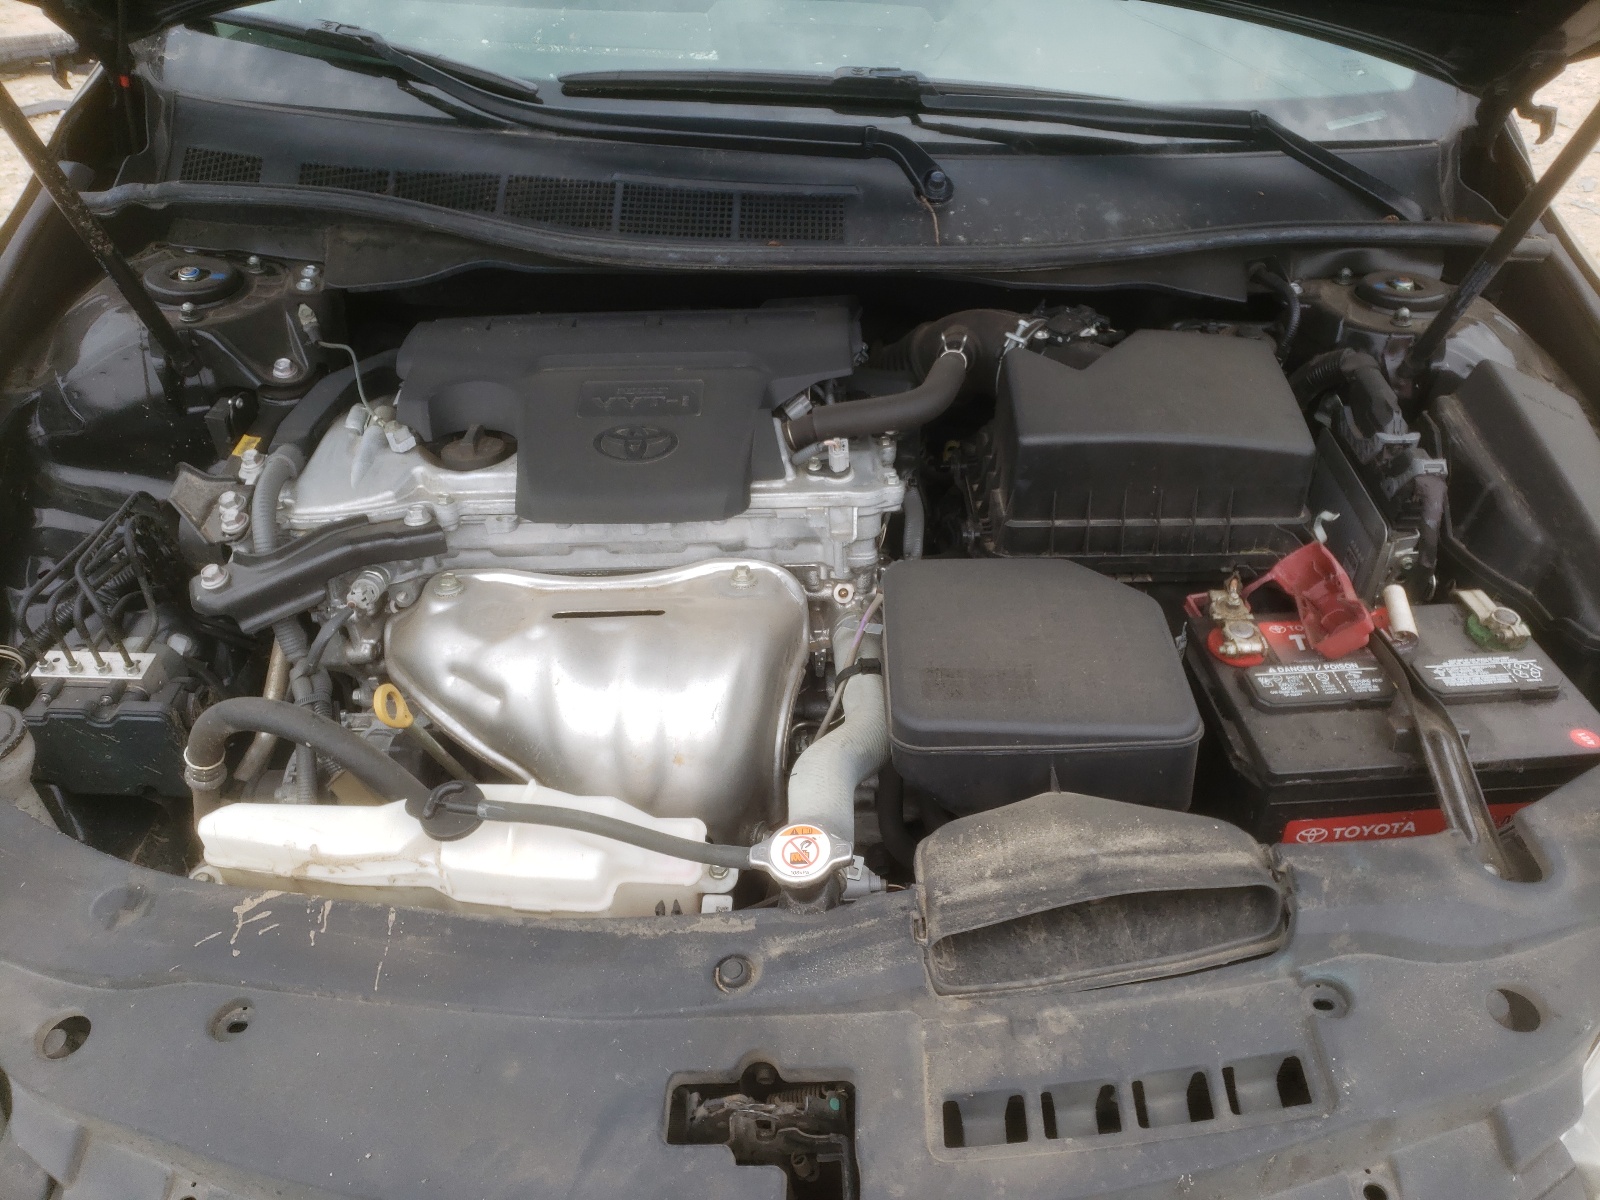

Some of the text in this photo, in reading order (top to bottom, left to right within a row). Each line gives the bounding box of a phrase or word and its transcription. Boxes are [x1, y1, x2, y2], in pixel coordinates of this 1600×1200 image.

[1277, 664, 1315, 673] DANGER
[1324, 662, 1359, 671] POISON
[1332, 821, 1416, 840] TOYOTA
